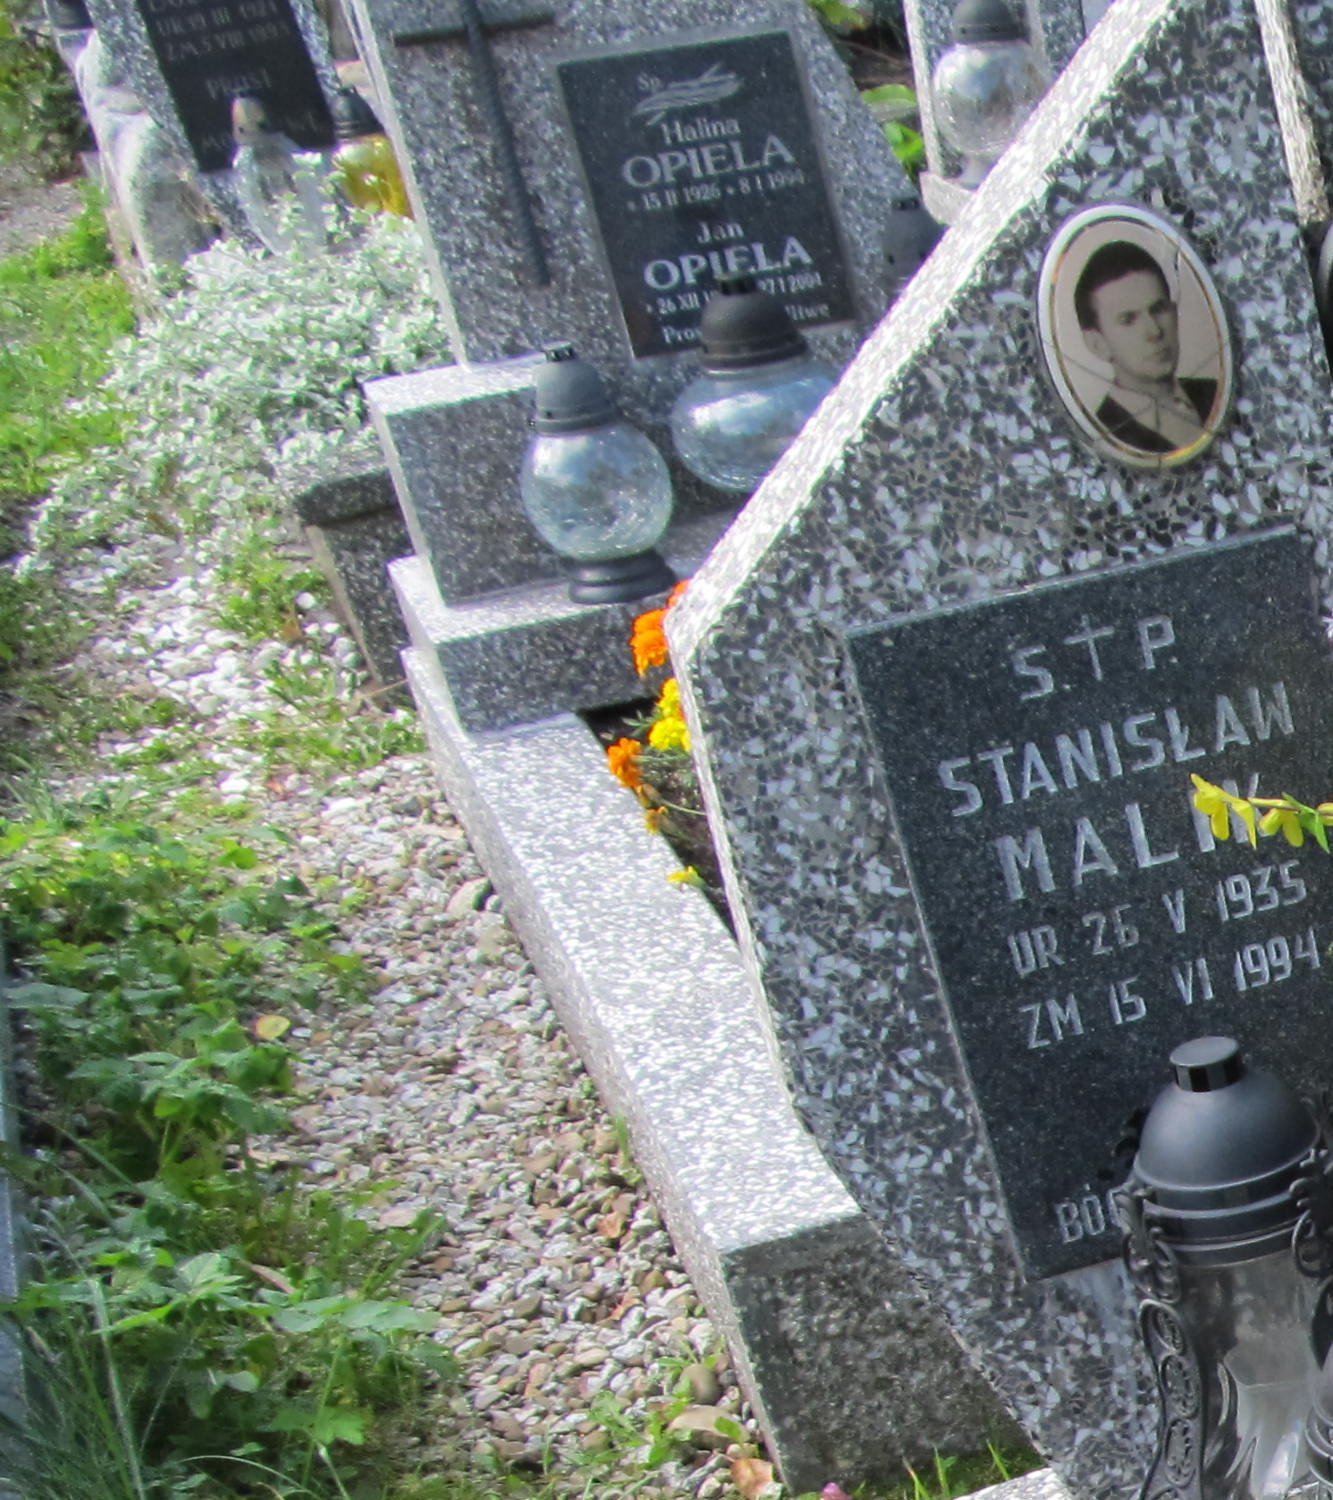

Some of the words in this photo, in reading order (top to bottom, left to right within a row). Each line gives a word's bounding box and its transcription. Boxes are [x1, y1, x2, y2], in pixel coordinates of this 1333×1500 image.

[661, 116, 741, 146] Halina
[622, 134, 798, 188] OPIELA
[697, 220, 745, 244] Jan
[643, 234, 814, 290] OPIELA
[1136, 614, 1176, 670] P
[937, 681, 1295, 817] STANISŁAW
[1007, 924, 1066, 979] UR
[1082, 904, 1141, 956] 26
[1161, 888, 1187, 934] V
[1214, 859, 1308, 923] 1935
[1018, 993, 1085, 1049] ZM
[1108, 975, 1147, 1025] 15
[1170, 957, 1214, 1006] VI
[1233, 926, 1321, 992] 1994
